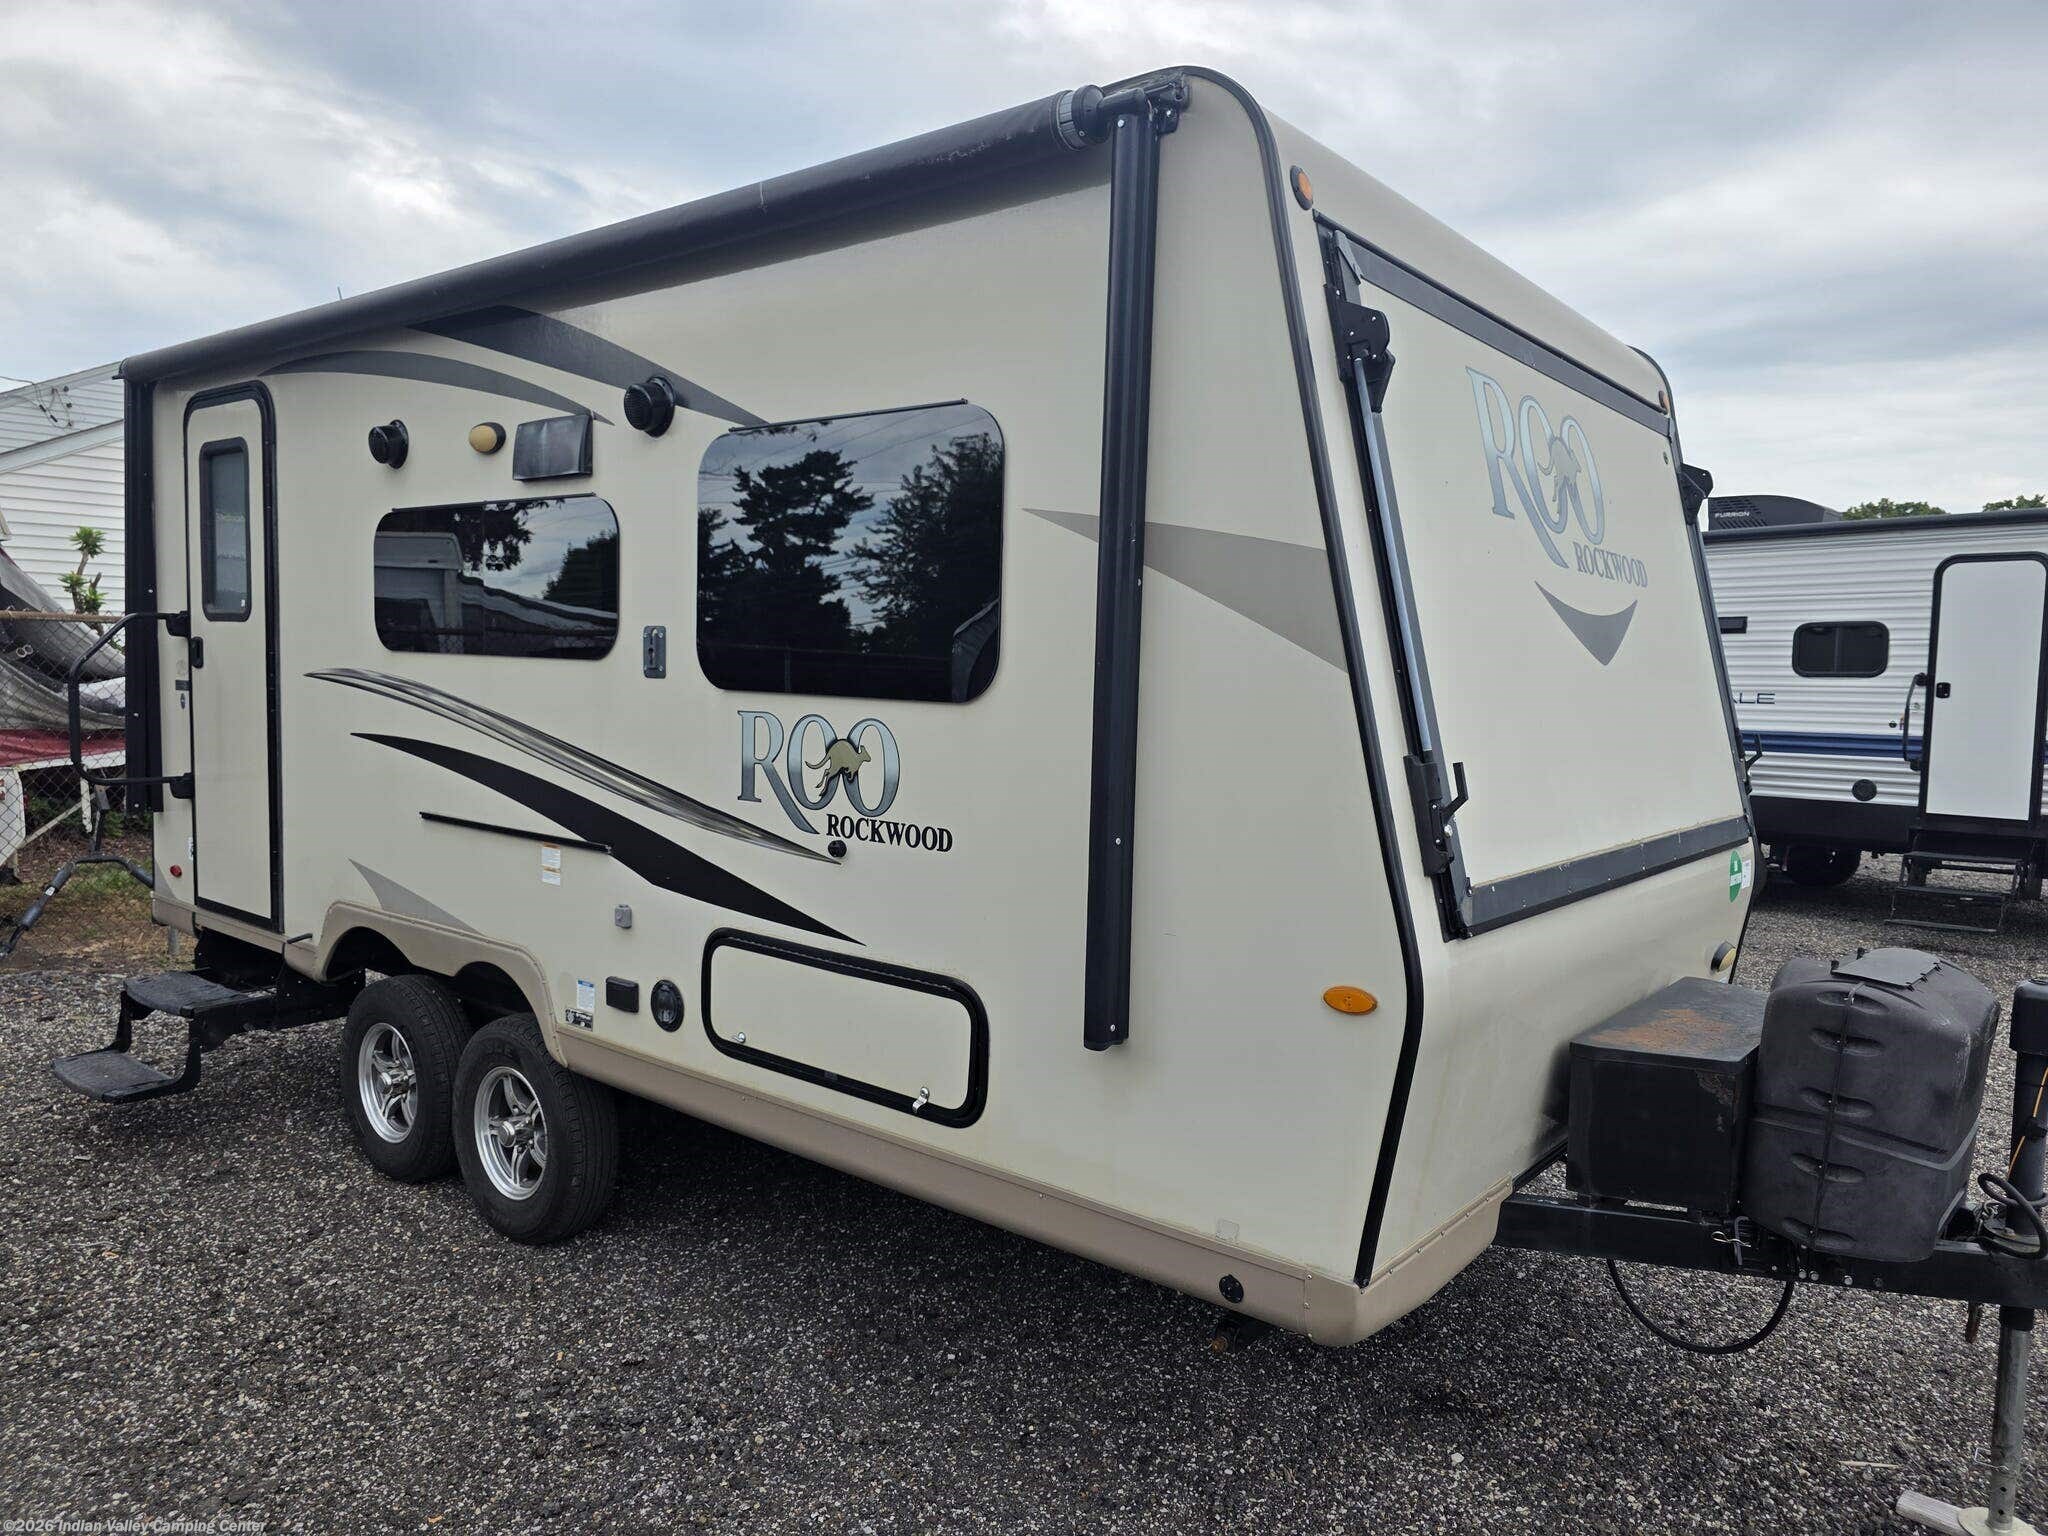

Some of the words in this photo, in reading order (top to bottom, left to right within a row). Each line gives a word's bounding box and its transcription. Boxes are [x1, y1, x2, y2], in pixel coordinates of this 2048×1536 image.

[1465, 365, 1606, 569] ROO
[1573, 540, 1648, 588] ROCKWOOD
[1732, 692, 1776, 704] LE
[737, 710, 901, 835] ROO
[826, 813, 954, 853] ROCKWOOD
